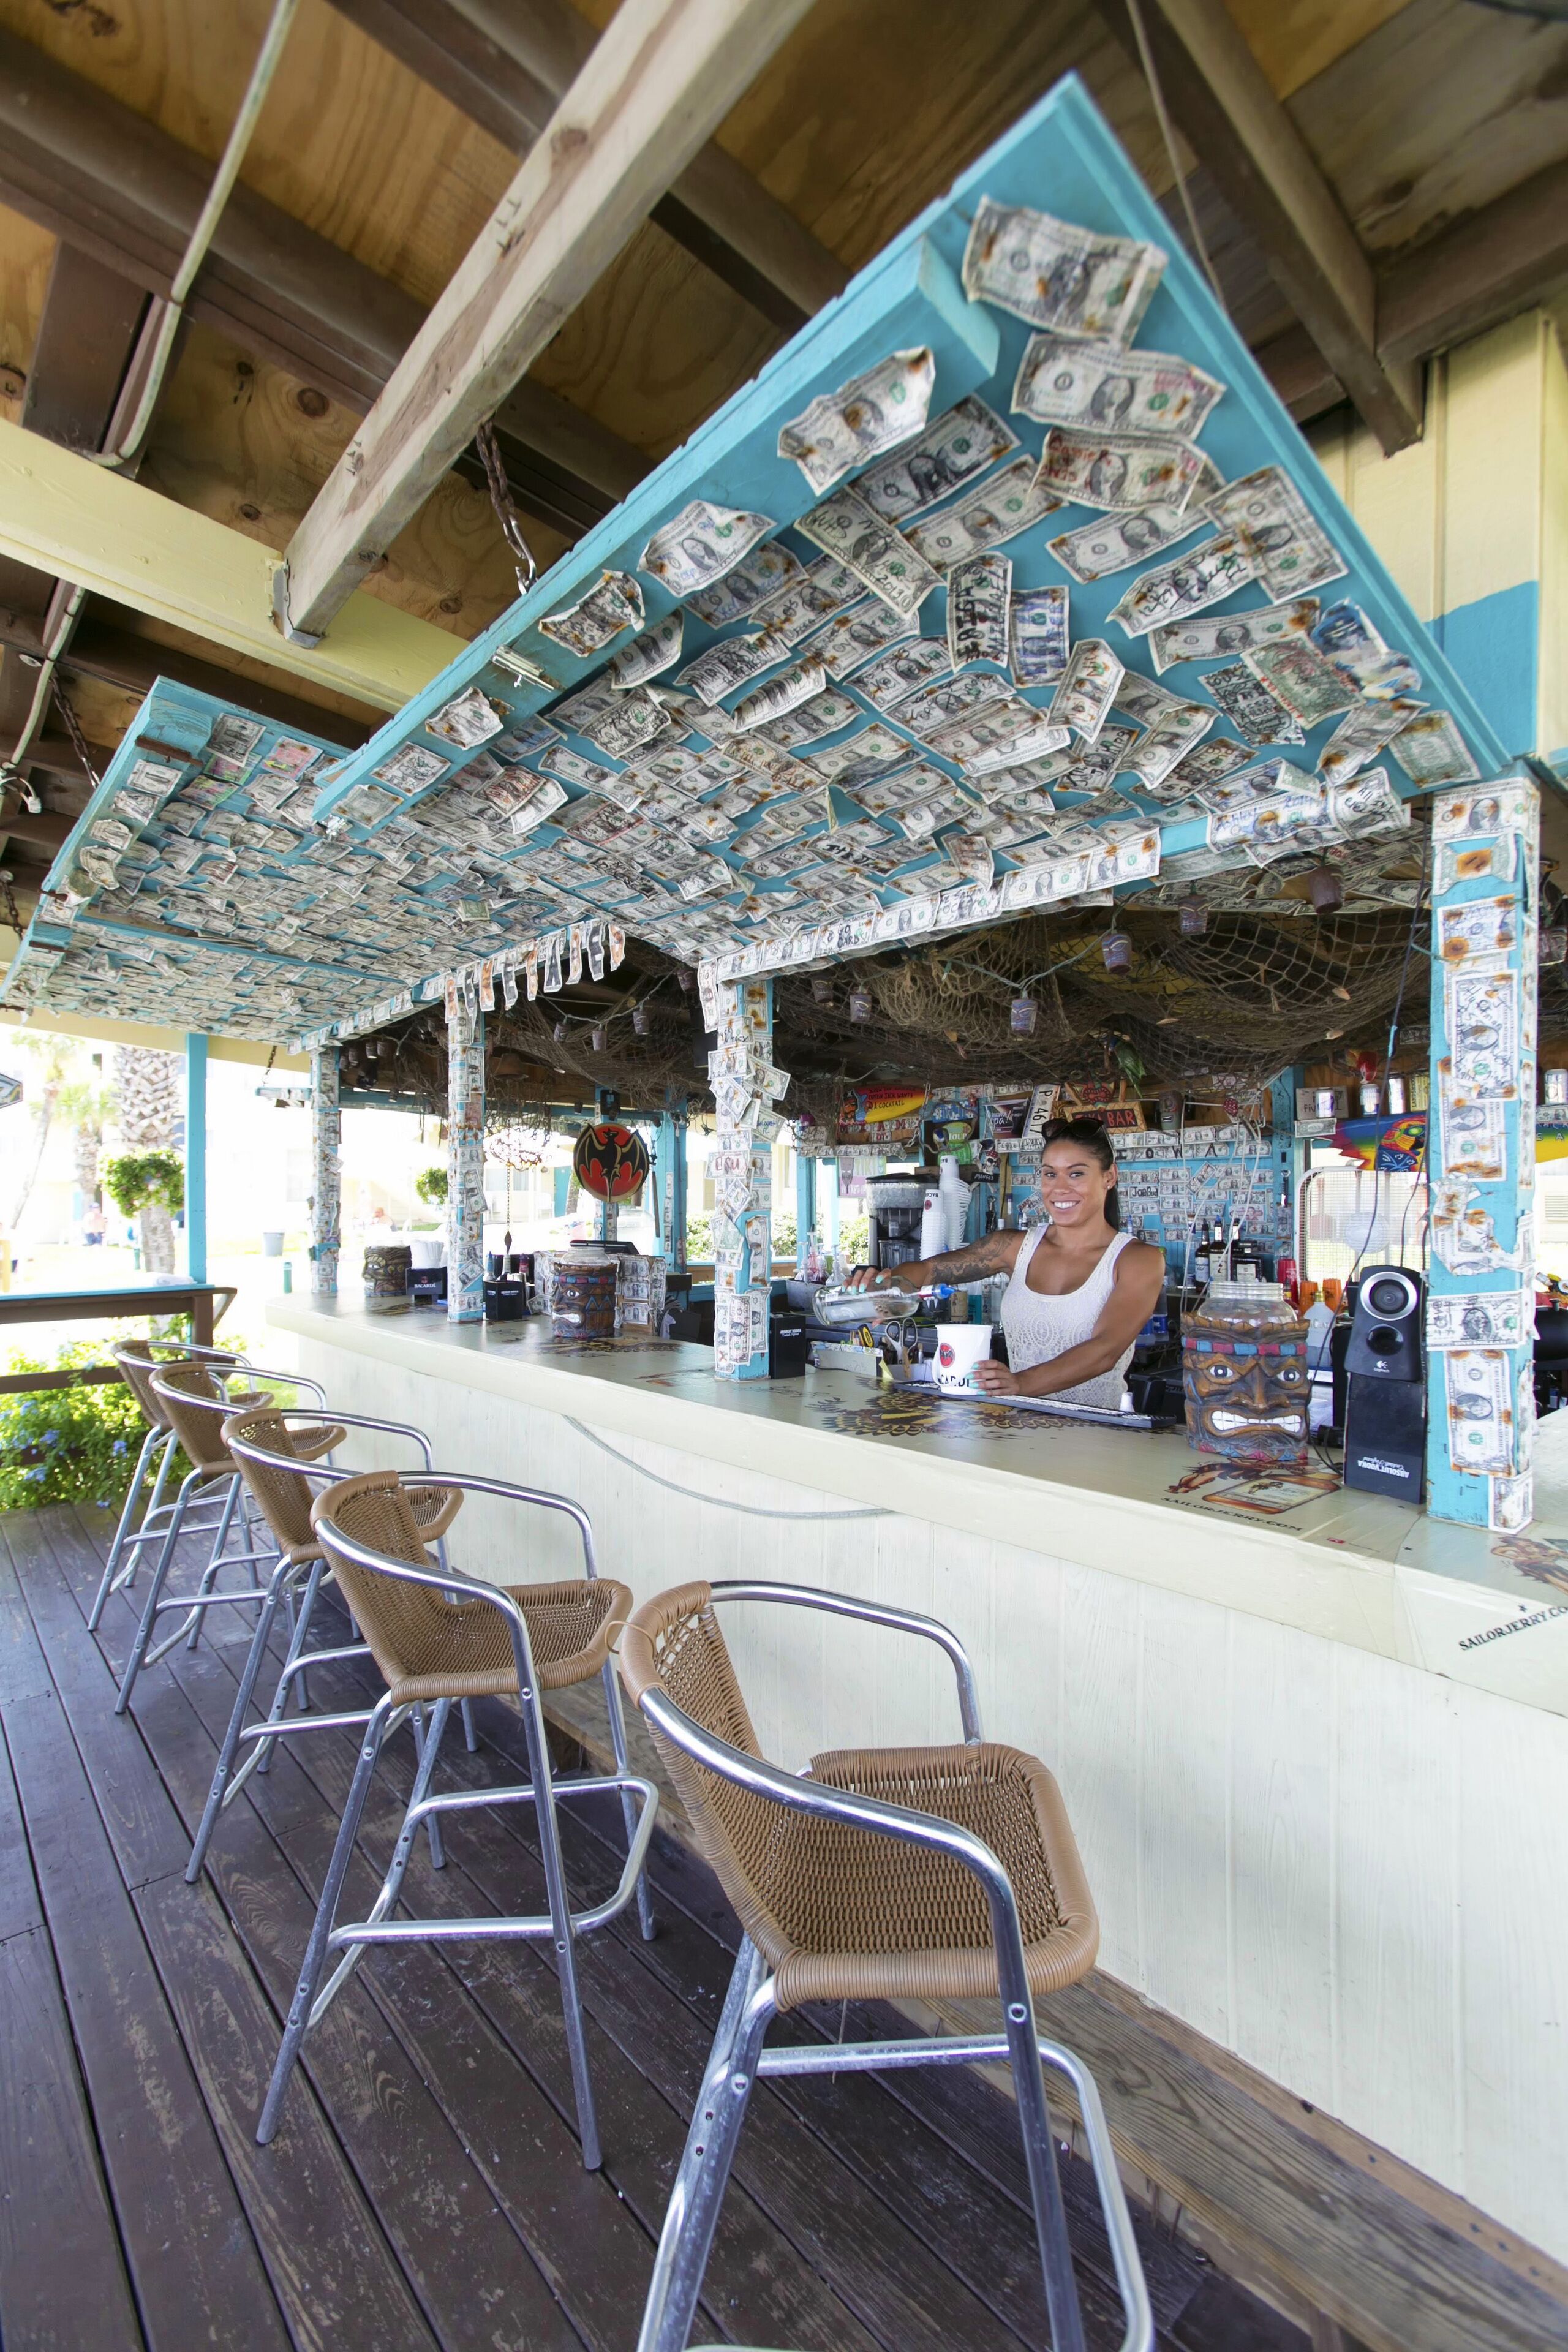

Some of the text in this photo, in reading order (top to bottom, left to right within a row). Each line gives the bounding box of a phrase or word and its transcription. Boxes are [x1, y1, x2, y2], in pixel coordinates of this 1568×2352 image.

[878, 1099, 904, 1108] COCKTAIL
[1107, 1110, 1134, 1127] BAR
[1356, 1460, 1409, 1478] ABSOLUT VODKA
[1161, 1497, 1303, 1531] SAILORJERRY.COM
